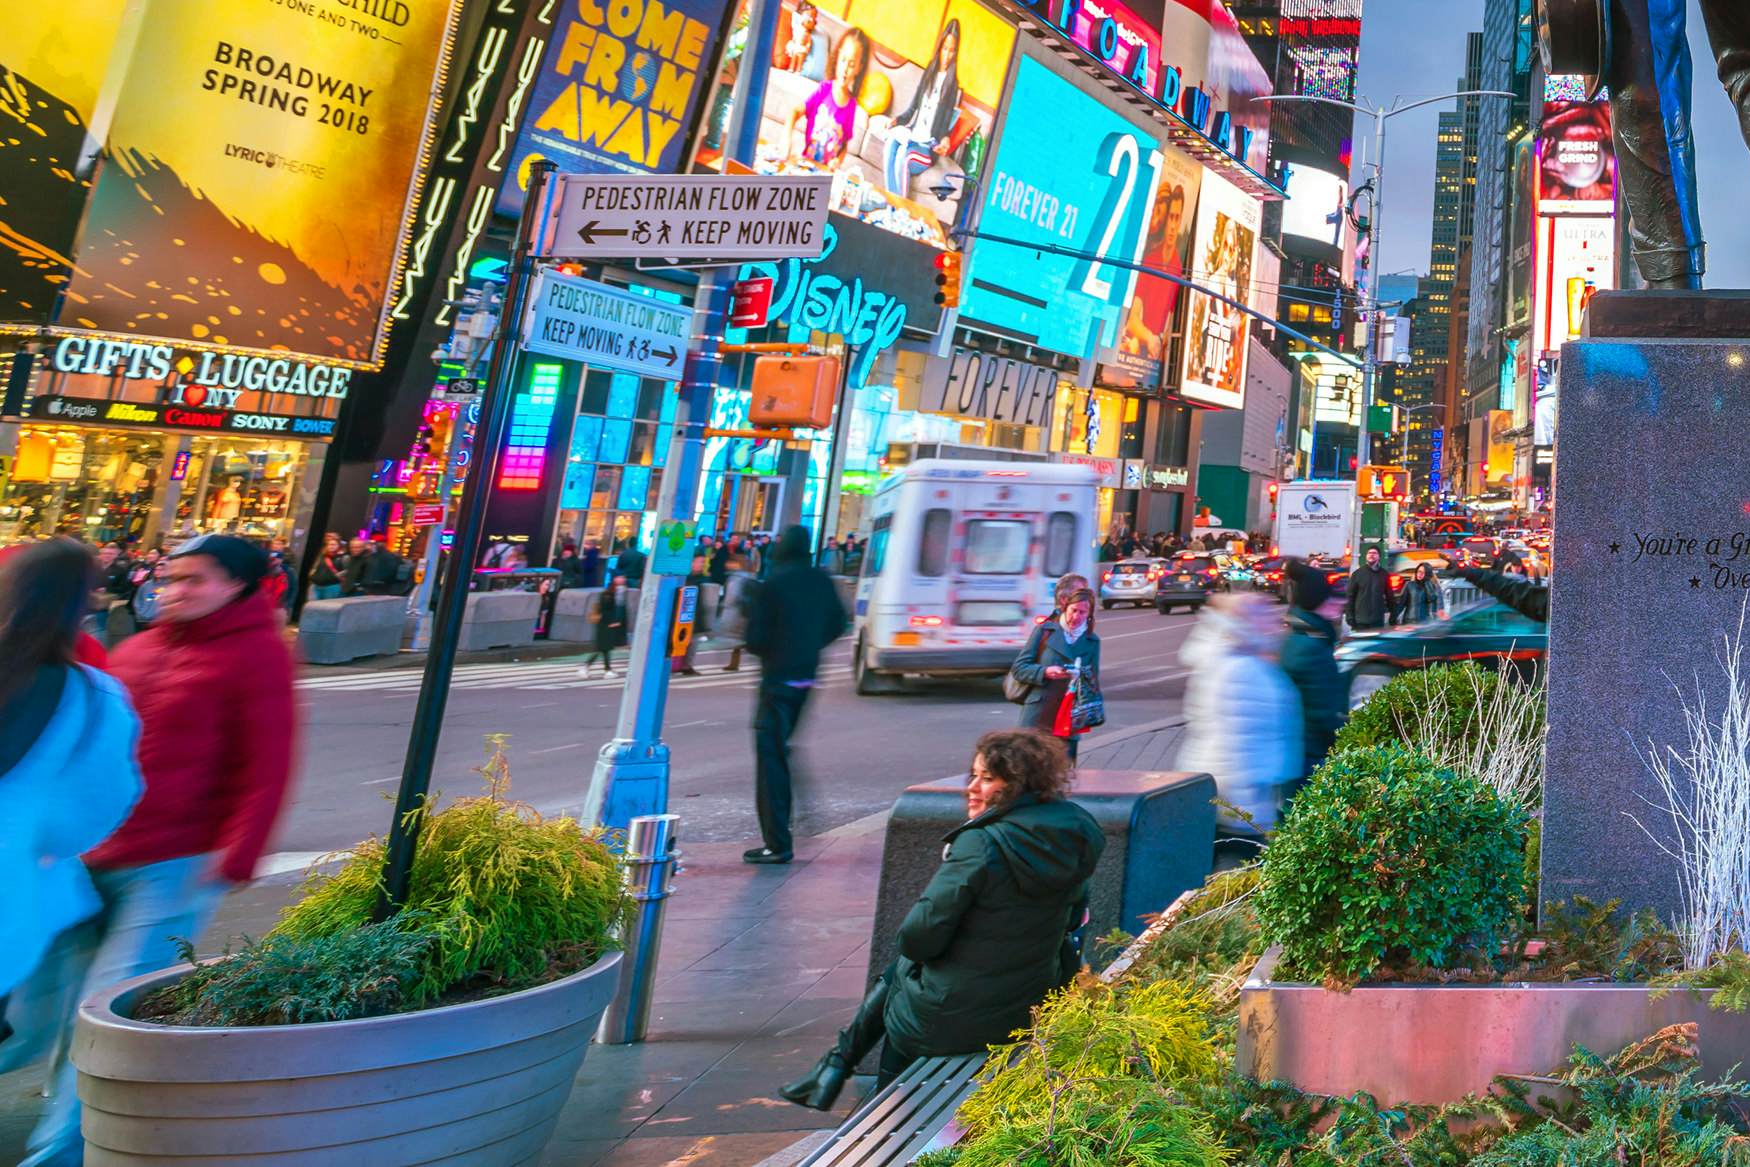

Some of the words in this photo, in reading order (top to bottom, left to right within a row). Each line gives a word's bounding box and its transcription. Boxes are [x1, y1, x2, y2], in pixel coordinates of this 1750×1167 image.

[317, 8, 347, 30] AND
[350, 19, 380, 41] TWO
[214, 40, 374, 109] BROADWAY
[555, 21, 702, 118] FROM
[202, 69, 307, 118] SPRING
[317, 104, 370, 135] 2018
[534, 81, 682, 170] AWAY
[224, 143, 265, 164] LYRIC
[273, 154, 327, 181] THEATRE
[1558, 140, 1599, 152] FRESH
[1558, 153, 1598, 164] GRIND
[582, 187, 702, 212] PEDESTRIAN
[708, 187, 762, 212] FLOW
[765, 187, 819, 212] ZONE
[991, 171, 1057, 232] FOREVER
[1059, 202, 1079, 240] 21
[1081, 133, 1165, 310] 21
[681, 220, 733, 244] KEEP
[736, 220, 814, 245] MOVING
[550, 283, 624, 324] PEDESTRIAN
[624, 299, 654, 329] FLOW
[655, 308, 686, 339] ZONE
[541, 316, 576, 346] KEEP
[576, 324, 623, 358] MOVING
[55, 337, 173, 381] GIFTS
[199, 352, 352, 400] LUGGAGE
[940, 347, 1059, 429] FOREVER
[62, 400, 98, 418] Apple
[105, 403, 158, 423] Nikon
[164, 407, 227, 428] Canon
[232, 413, 290, 432] SONY
[1632, 531, 1697, 563] You're
[1705, 539, 1721, 556] a
